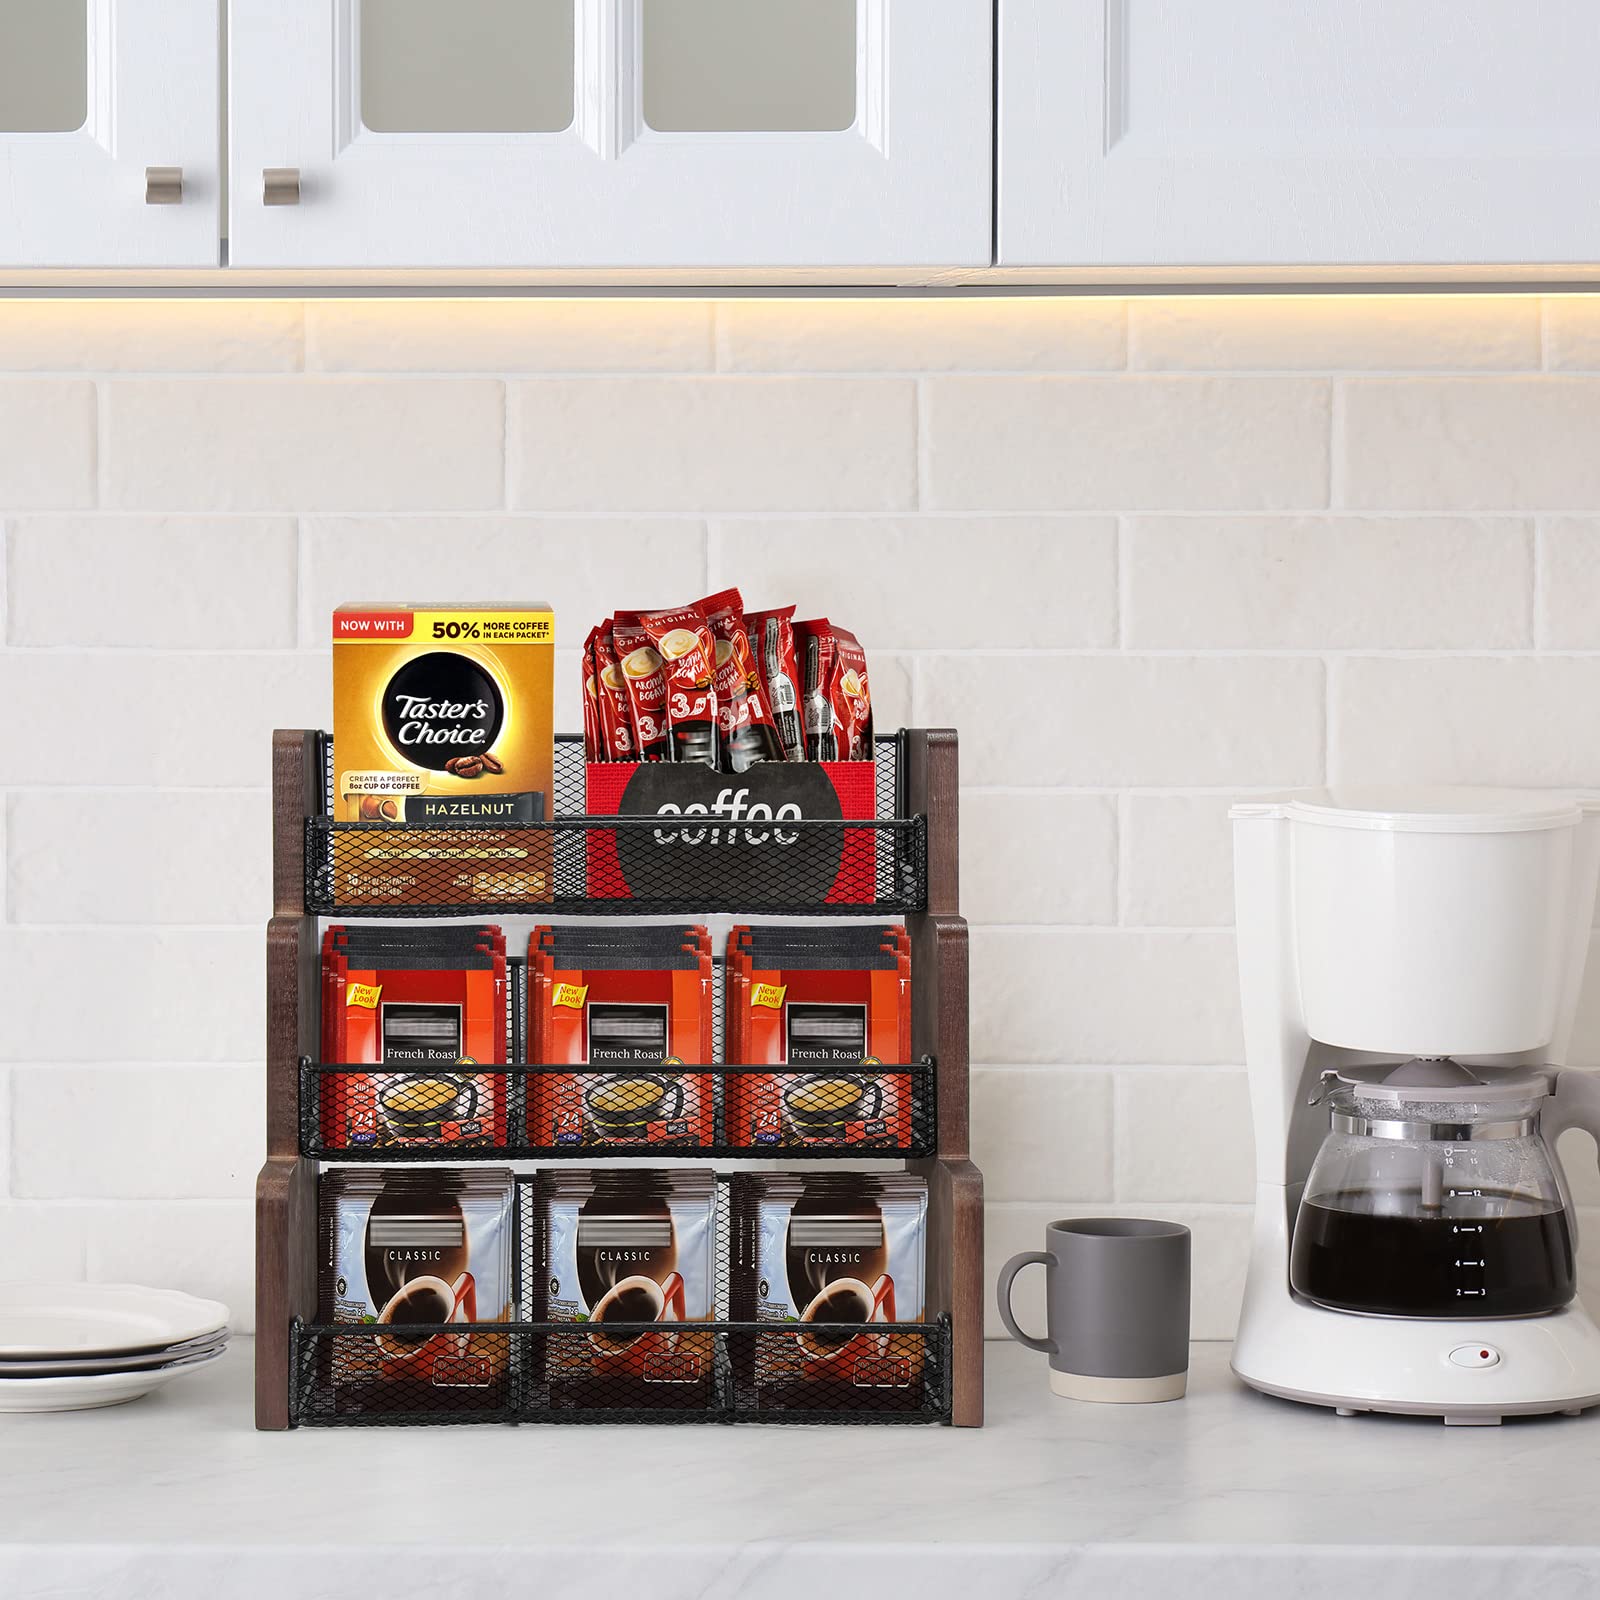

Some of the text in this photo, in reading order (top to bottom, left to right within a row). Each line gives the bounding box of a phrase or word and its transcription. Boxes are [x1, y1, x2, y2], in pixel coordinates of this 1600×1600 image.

[340, 620, 405, 631] NOW WITH
[483, 622, 549, 631] MORE COFFEE
[646, 612, 700, 629] ORIGINAL
[432, 621, 480, 639] 50%
[395, 694, 489, 719] Taster's
[671, 692, 690, 718] 3
[706, 692, 718, 716] 1
[719, 706, 736, 730] 3
[747, 694, 764, 719] 1
[638, 715, 658, 741] 3
[615, 726, 631, 751] 3
[425, 803, 514, 815] HAZELNUT
[653, 788, 802, 845] coffee
[354, 986, 372, 995] New
[559, 986, 579, 995] New
[758, 986, 777, 995] New
[353, 994, 375, 1004] Look
[559, 994, 581, 1004] Look
[758, 994, 780, 1004] Look
[387, 1048, 457, 1060] French Roast
[593, 1048, 664, 1060] French Roast
[791, 1048, 862, 1060] French Roast
[354, 1111, 374, 1127] 24
[561, 1111, 580, 1127] 24
[759, 1111, 778, 1127] 24
[389, 1251, 441, 1261] CLASSIC
[600, 1252, 650, 1261] CLASSIC
[810, 1253, 860, 1263] CLASSIC
